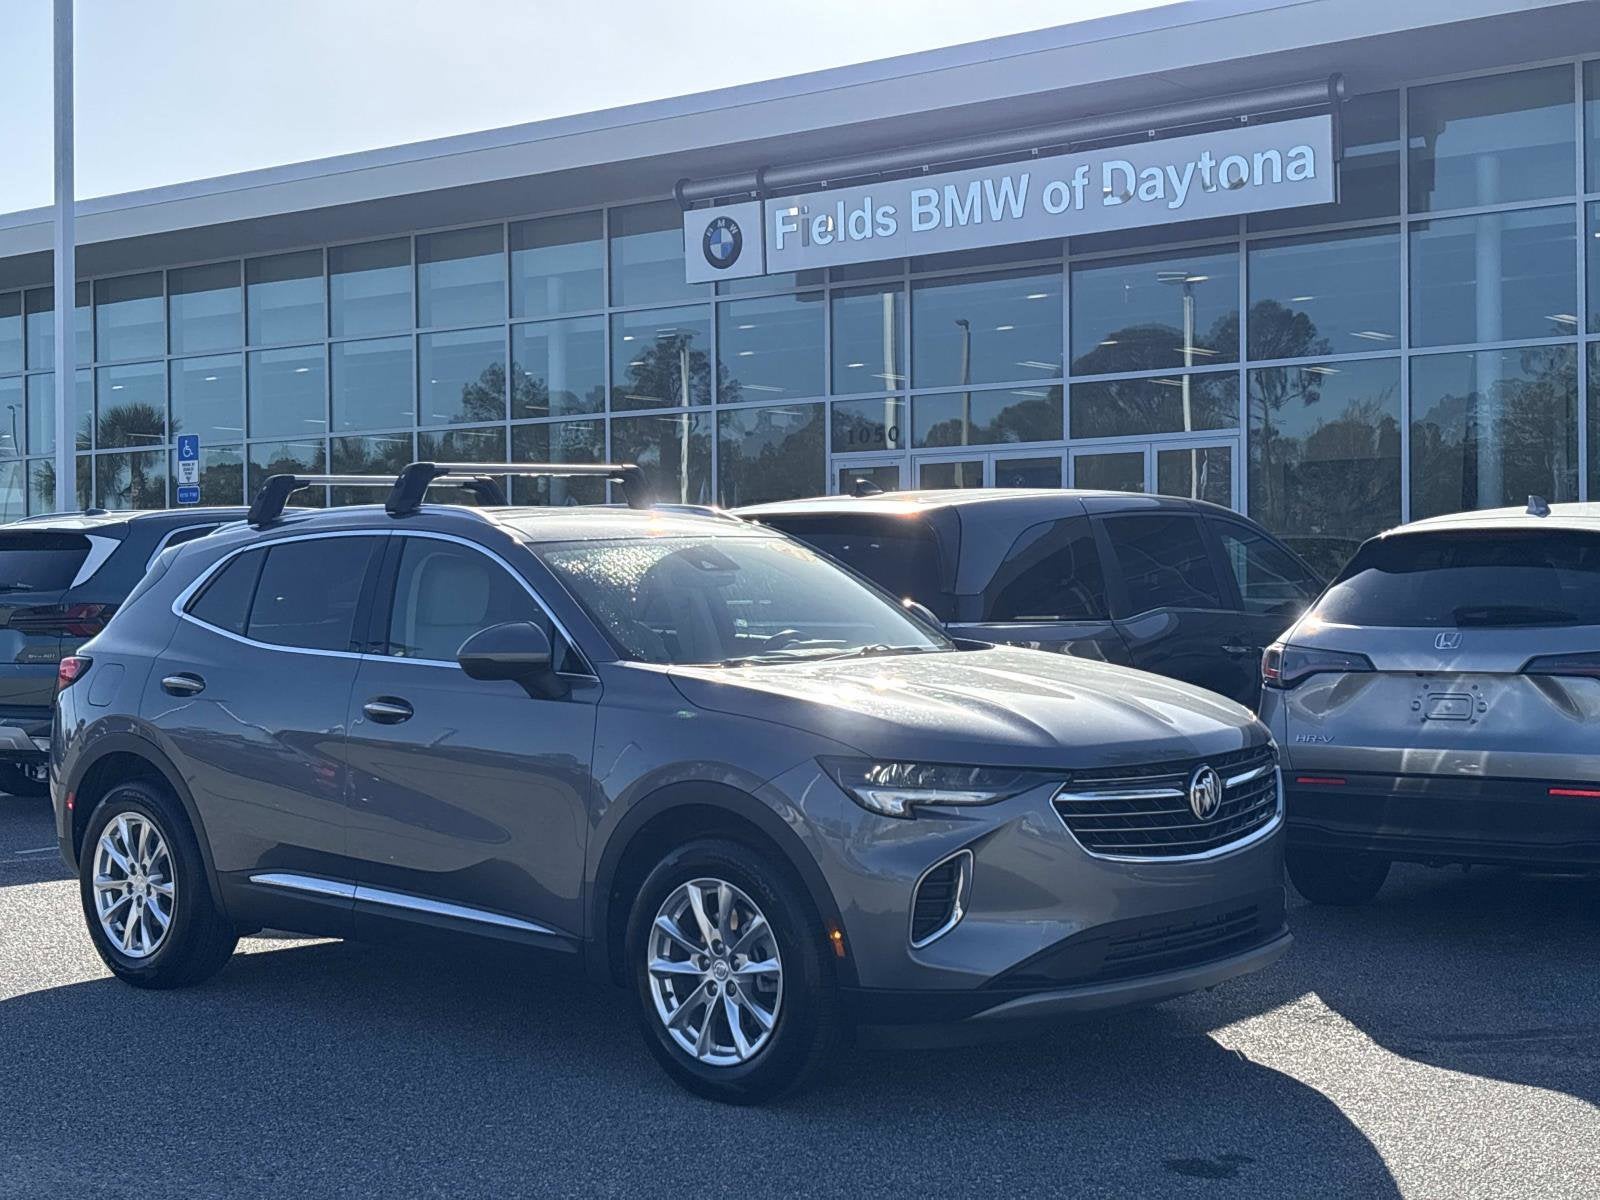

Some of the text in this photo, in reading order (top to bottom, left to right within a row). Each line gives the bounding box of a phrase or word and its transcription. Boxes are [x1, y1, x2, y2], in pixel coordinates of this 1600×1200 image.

[775, 144, 1316, 250] Fields BMW of Daytona
[847, 425, 899, 445] 1050
[1295, 734, 1336, 743] HR-V
